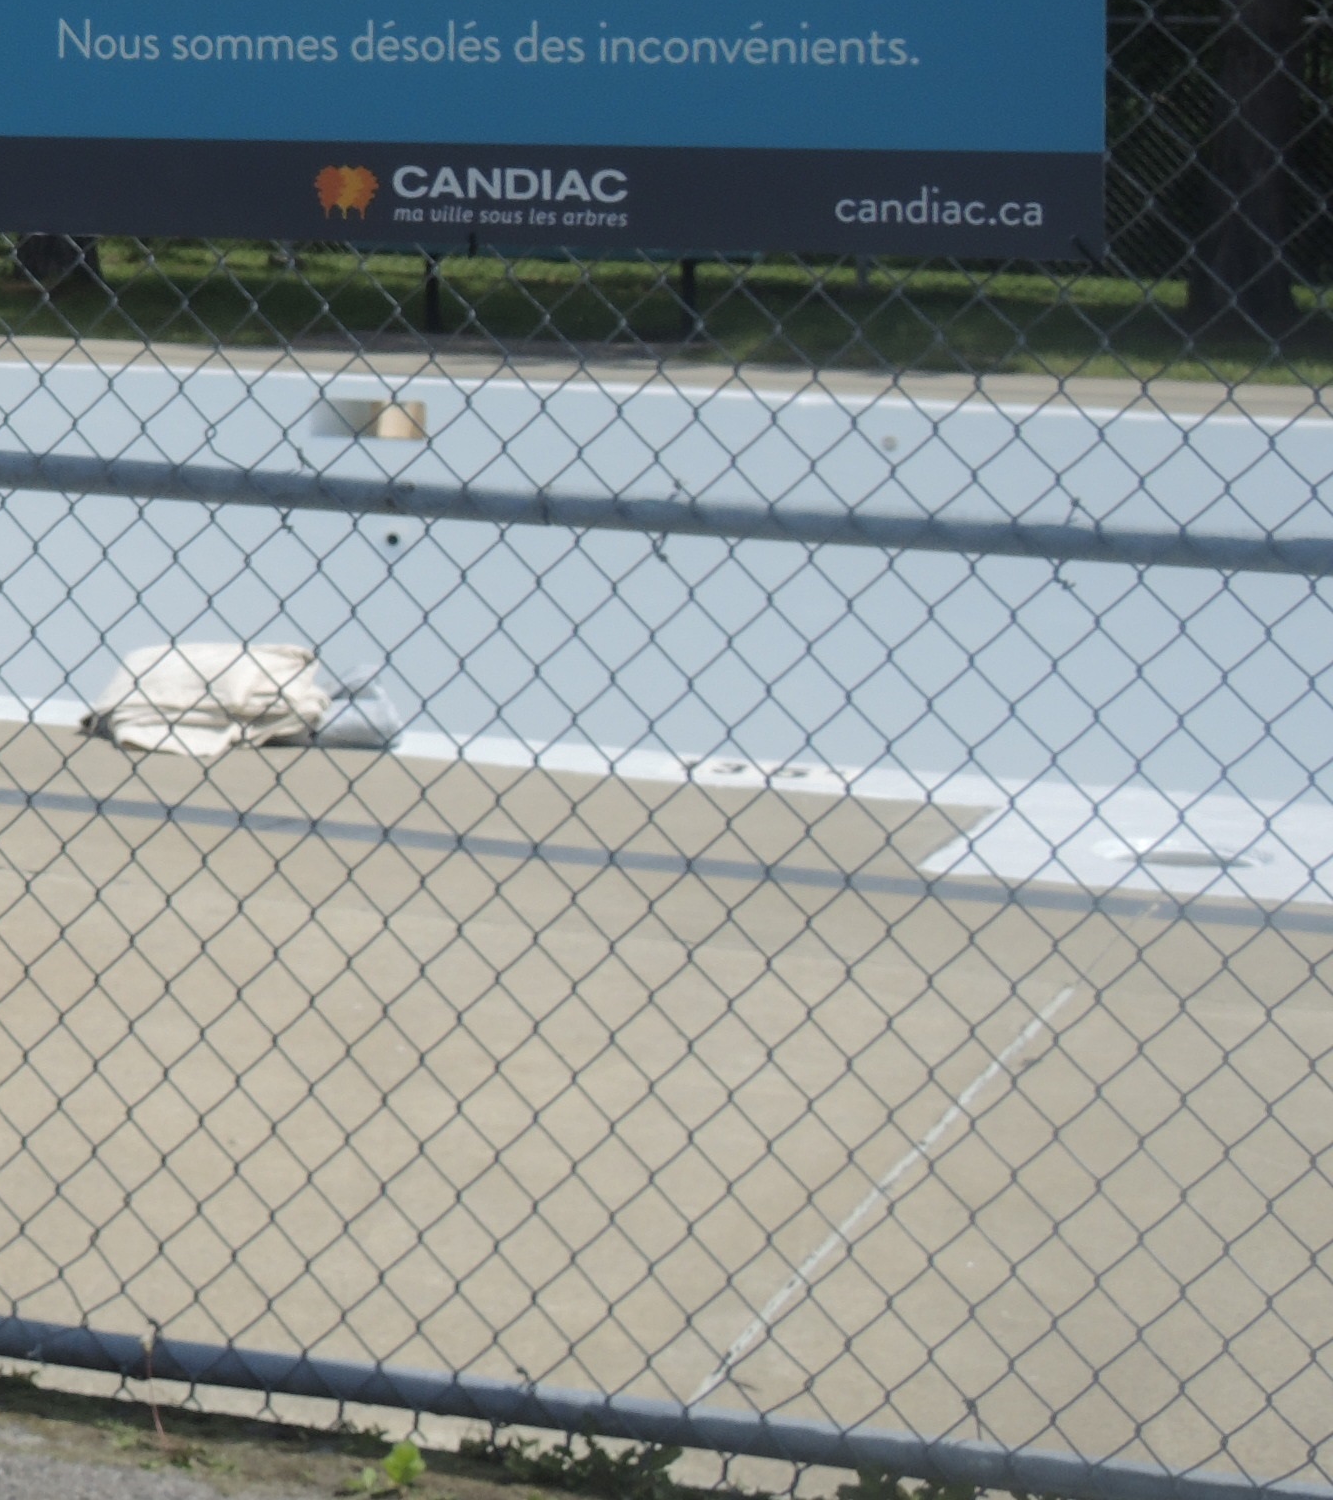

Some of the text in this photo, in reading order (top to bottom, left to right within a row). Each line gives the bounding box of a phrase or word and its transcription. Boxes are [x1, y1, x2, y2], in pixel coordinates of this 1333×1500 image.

[57, 17, 921, 65] Nous sommes désolés des inconvénients.
[392, 164, 629, 204] CANDIAC
[393, 205, 629, 227] ma ville sous les arbres
[834, 186, 1044, 227] candiac.ca
